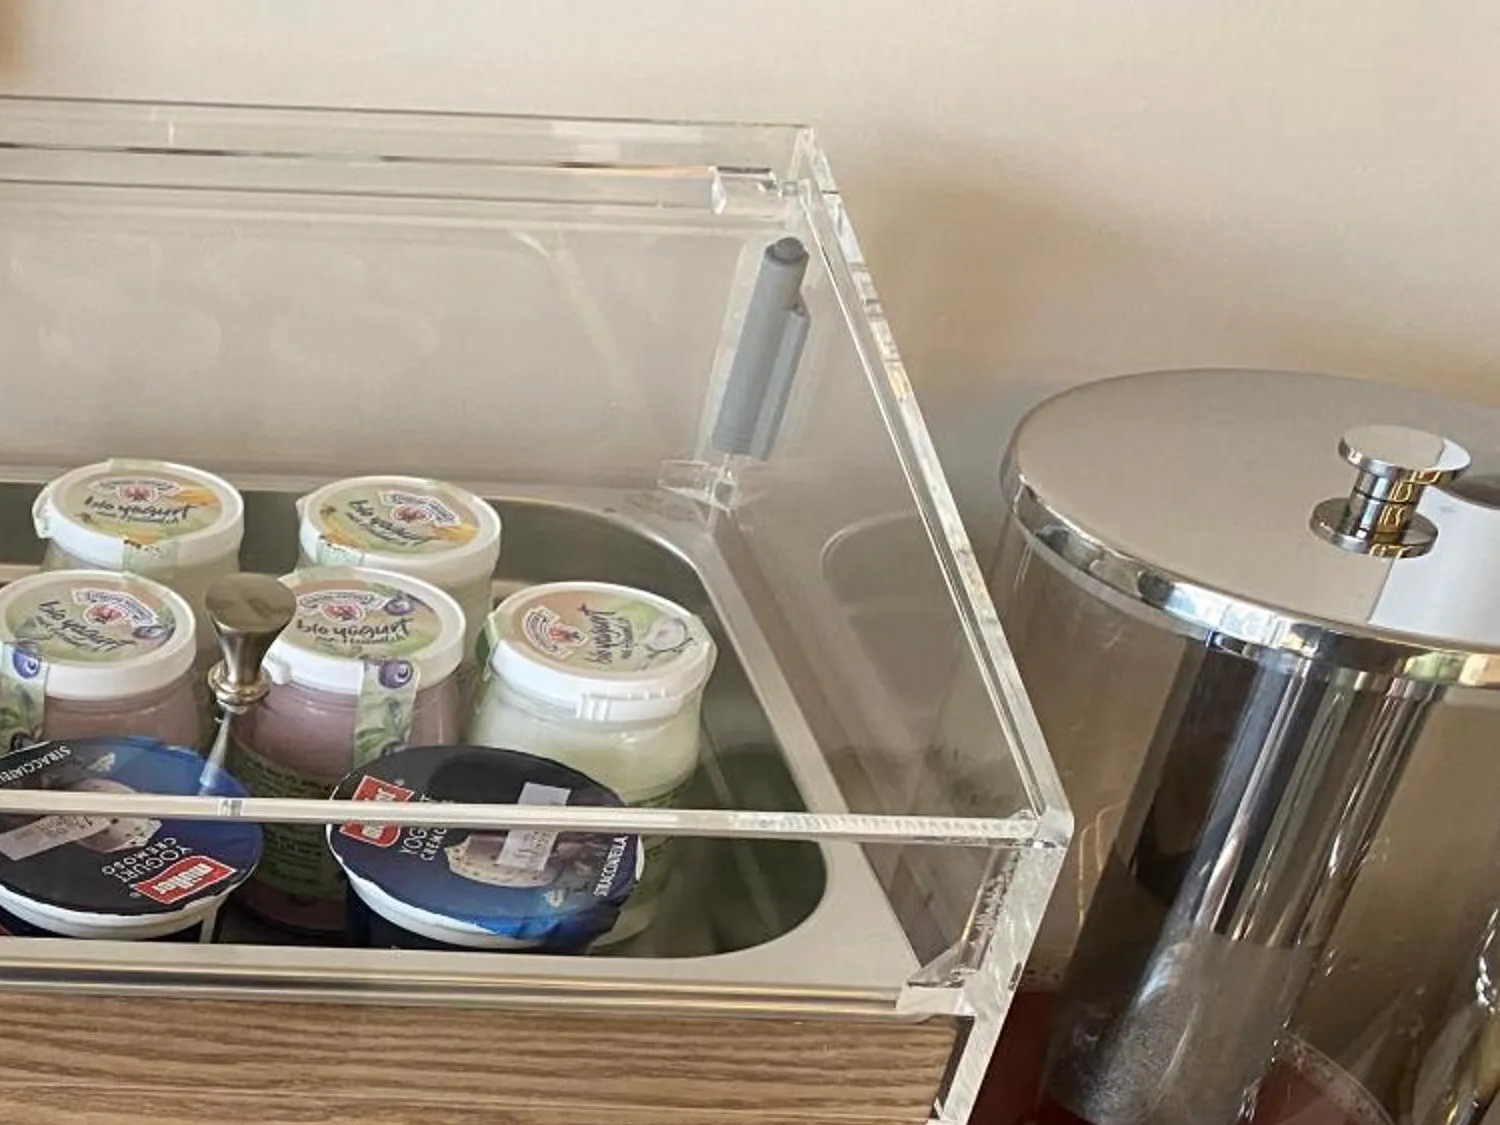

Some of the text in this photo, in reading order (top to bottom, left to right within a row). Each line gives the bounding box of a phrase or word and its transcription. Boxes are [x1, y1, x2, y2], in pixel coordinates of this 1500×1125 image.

[118, 503, 198, 521] yogurt
[296, 617, 415, 642] bio yogurt
[100, 836, 178, 876] CREMOSO
[117, 846, 194, 883] YOGURT
